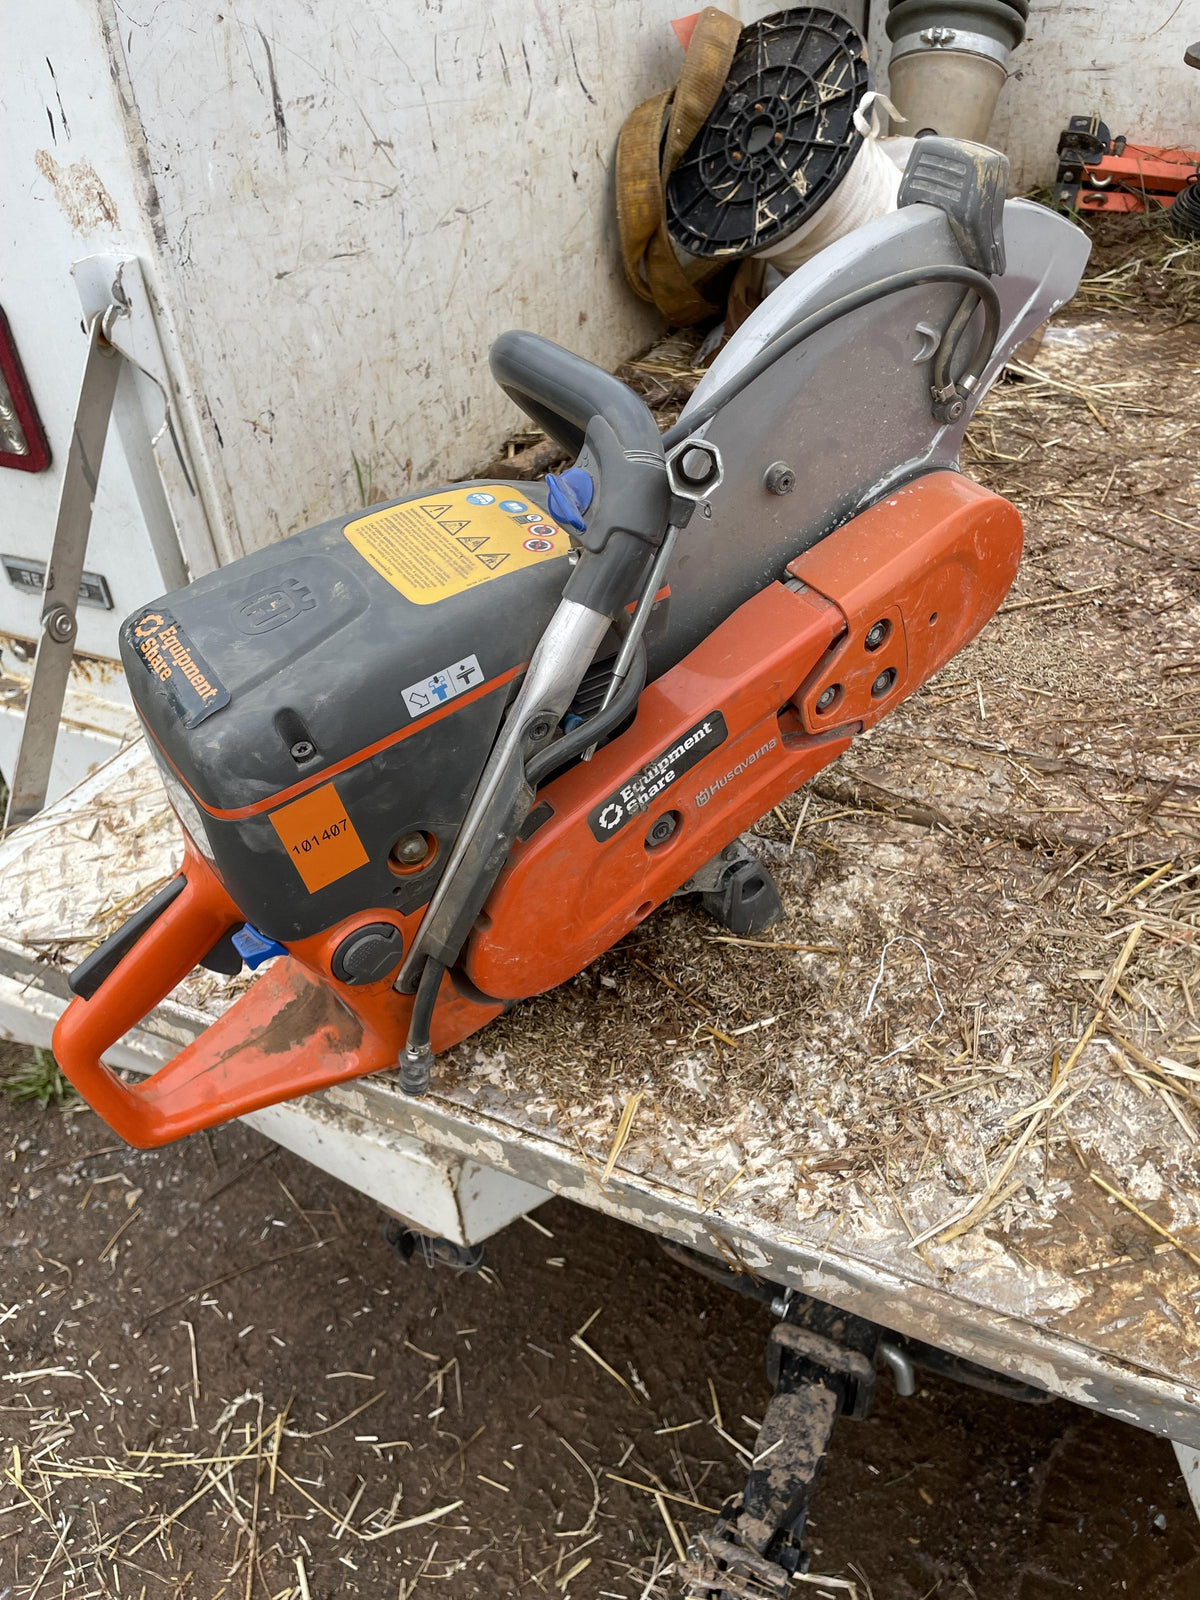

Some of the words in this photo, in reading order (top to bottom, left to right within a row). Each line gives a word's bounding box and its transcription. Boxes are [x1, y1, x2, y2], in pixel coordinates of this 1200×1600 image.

[141, 637, 172, 682] Share
[158, 625, 218, 702] Equipment
[620, 722, 713, 803] Equipment
[709, 737, 778, 795] Husqvarna
[292, 818, 347, 854] 101407
